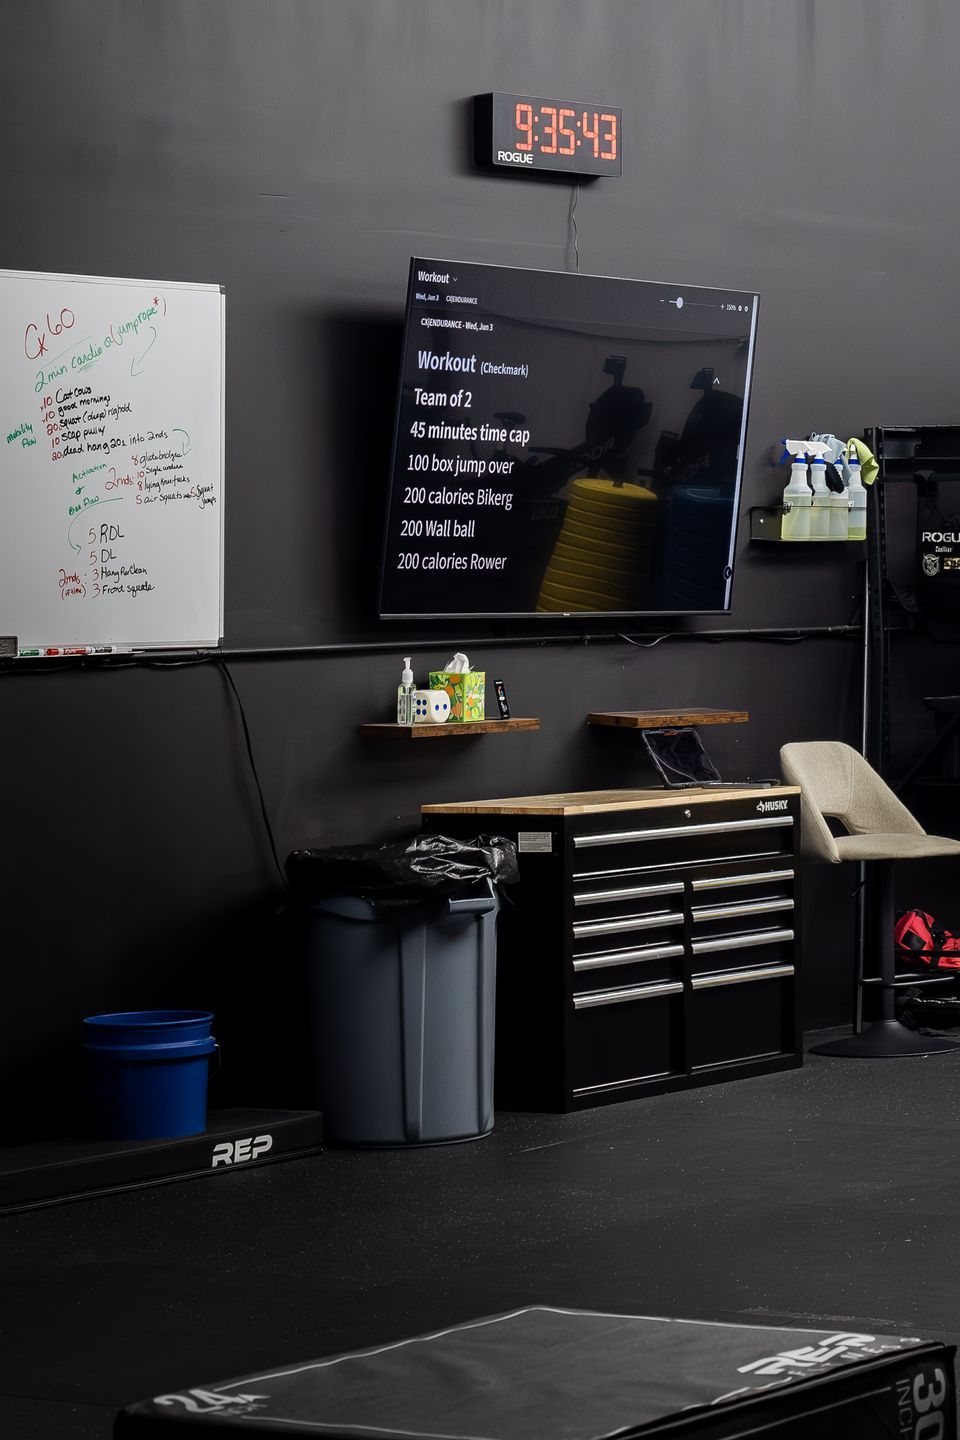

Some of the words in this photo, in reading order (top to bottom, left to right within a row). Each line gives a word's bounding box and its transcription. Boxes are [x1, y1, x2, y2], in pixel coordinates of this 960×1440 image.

[515, 104, 617, 160] 9:35:43
[498, 150, 534, 164] ROGUE
[418, 271, 450, 284] Workout
[479, 323, 489, 331] Jun
[490, 323, 494, 332] 3
[418, 350, 477, 373] Workout
[480, 361, 529, 379] (Checkmark)
[414, 388, 447, 406] Team
[449, 389, 464, 407] of
[464, 391, 472, 407] 2
[410, 421, 426, 438] 45
[428, 421, 478, 441] minutes
[480, 423, 507, 442] time
[509, 429, 530, 447] cap
[407, 454, 429, 471] 100
[431, 453, 453, 471] box
[454, 455, 486, 477] jump
[488, 460, 514, 474] over
[403, 487, 426, 504] 200
[428, 486, 474, 505] calories
[476, 488, 513, 511] Bikerg
[100, 523, 125, 543] RDL
[400, 520, 423, 537] 200
[425, 520, 450, 537] Wall
[453, 520, 475, 538] ball
[101, 549, 116, 563] DL
[397, 553, 420, 570] 200
[421, 552, 467, 571] calories
[470, 553, 507, 570] Rower
[765, 800, 788, 811] HUSKY
[211, 1134, 273, 1168] REP
